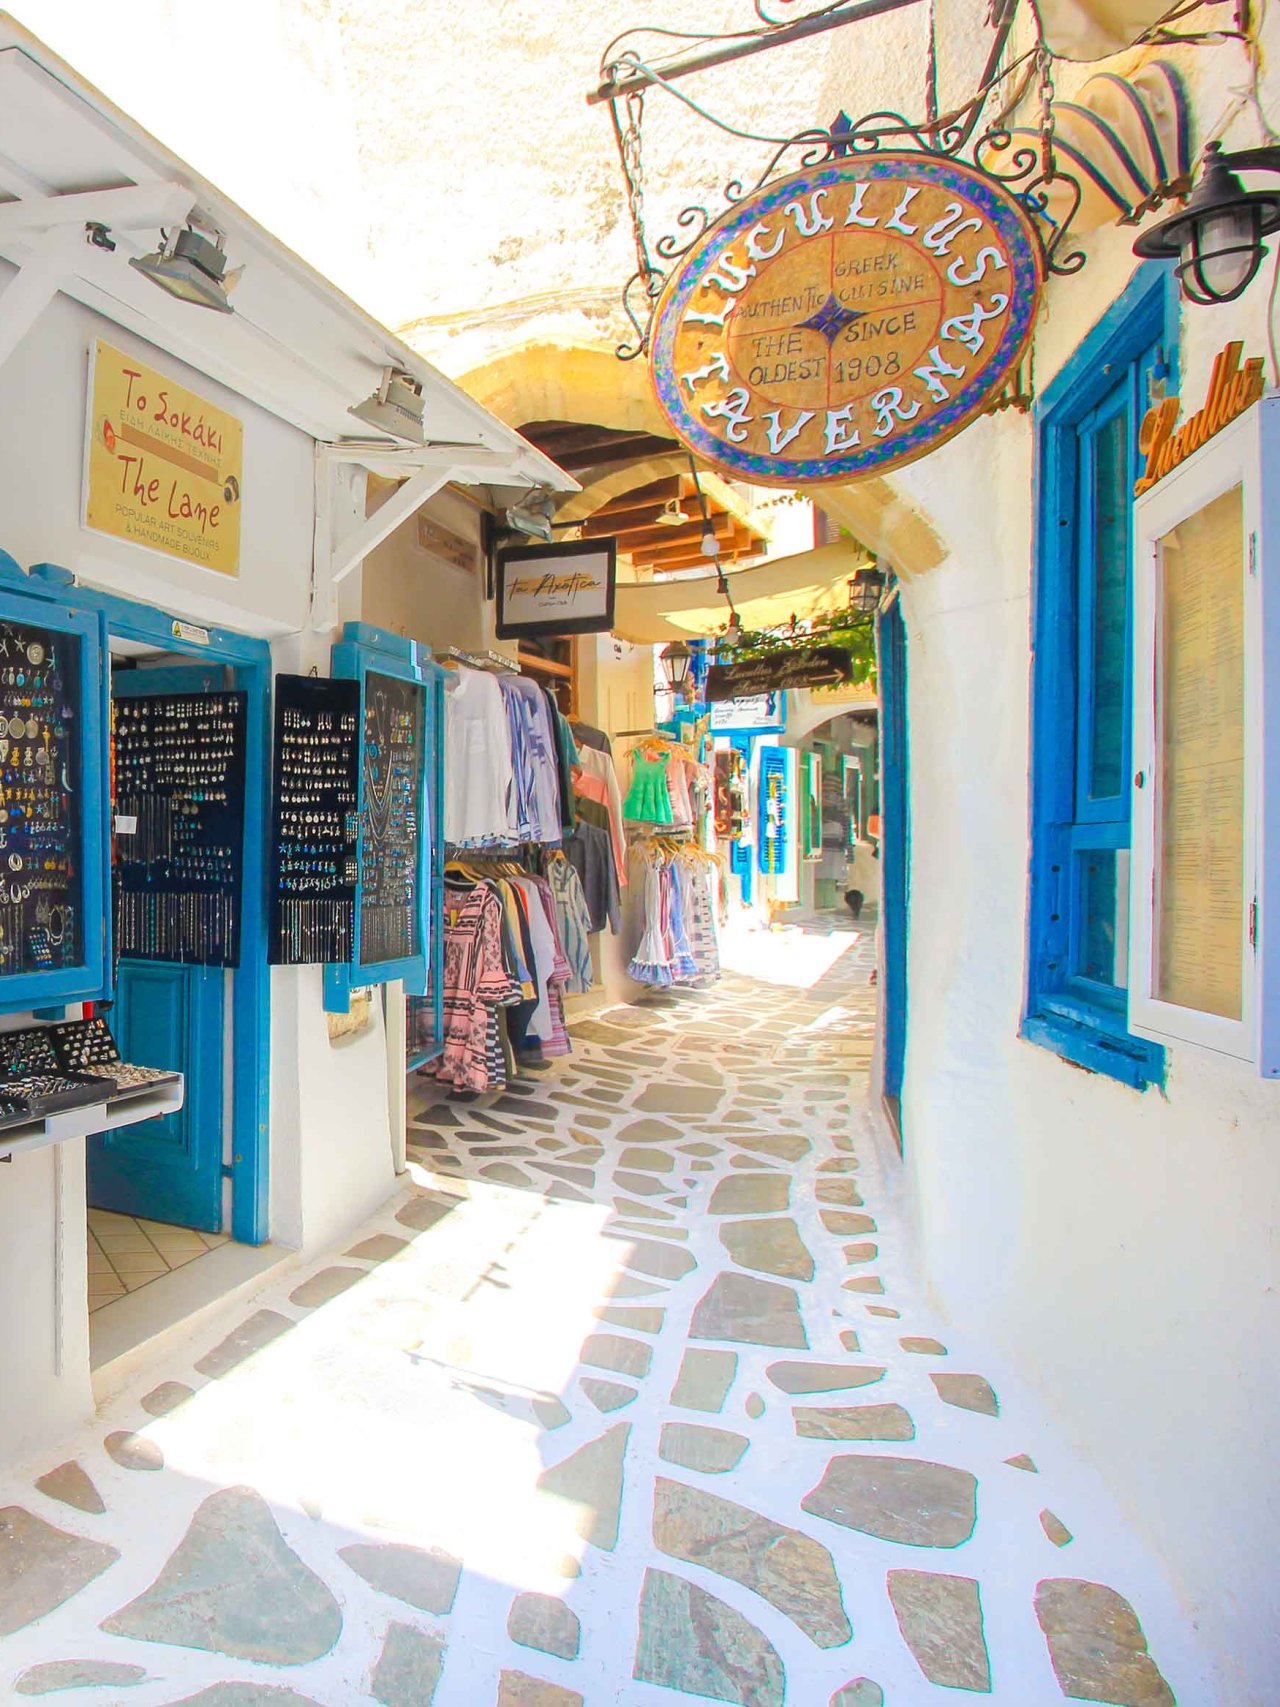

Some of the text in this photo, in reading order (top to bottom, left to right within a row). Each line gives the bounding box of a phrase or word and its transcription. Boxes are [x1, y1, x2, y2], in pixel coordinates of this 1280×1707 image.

[682, 182, 1009, 326] LUCULLUS
[834, 252, 900, 278] GREEK
[733, 286, 824, 320] AUTHENTIC
[838, 275, 925, 302] CUISINE
[843, 310, 917, 343] SINCE
[752, 332, 804, 360] THE
[681, 292, 1009, 454] TAVERNA
[748, 356, 828, 386] OLDEST
[834, 350, 902, 383] 1908
[119, 408, 144, 430] ΕΙΔΗ
[117, 454, 220, 534] The Lane
[115, 503, 220, 552] POPULAR ART SOUVENIRS
[124, 522, 211, 561] & HANDMADE BIJOUX
